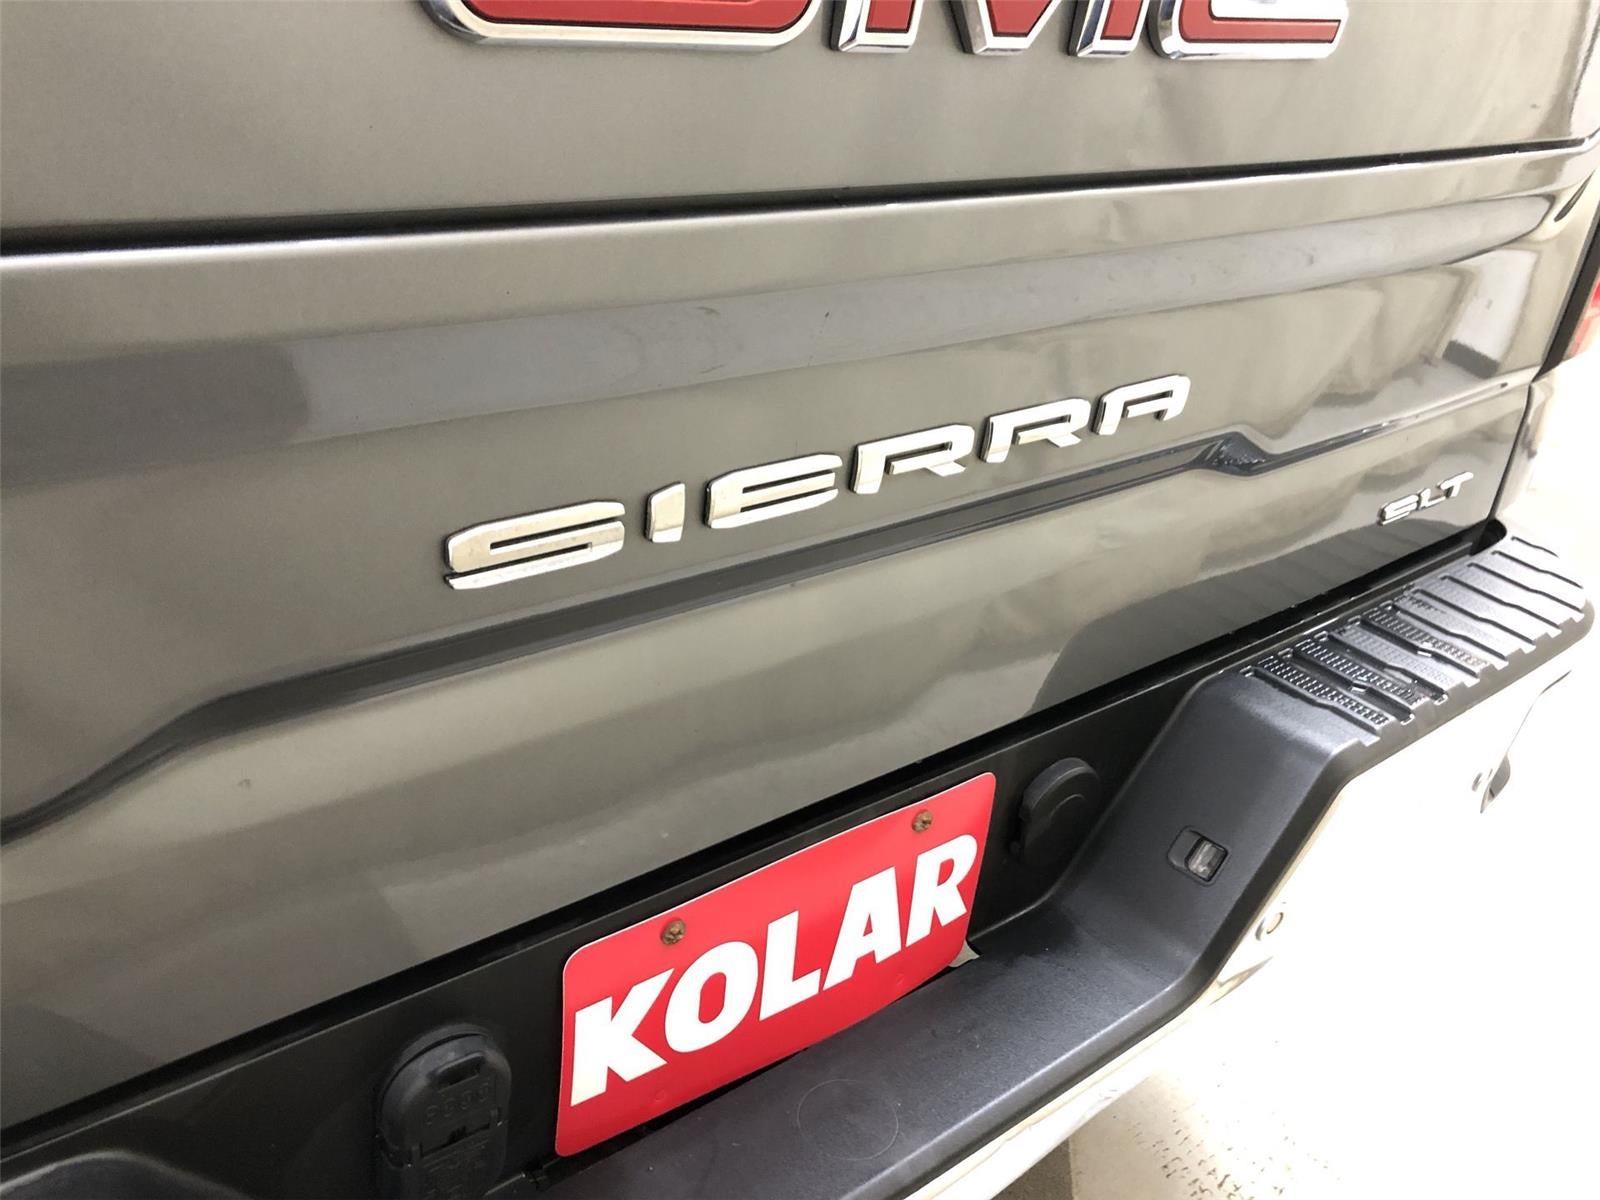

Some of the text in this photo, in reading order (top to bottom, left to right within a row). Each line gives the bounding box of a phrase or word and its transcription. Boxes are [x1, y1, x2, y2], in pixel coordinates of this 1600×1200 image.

[444, 374, 1191, 590] SIERRA
[1378, 471, 1474, 526] SLT
[570, 834, 978, 1107] KOLAR
